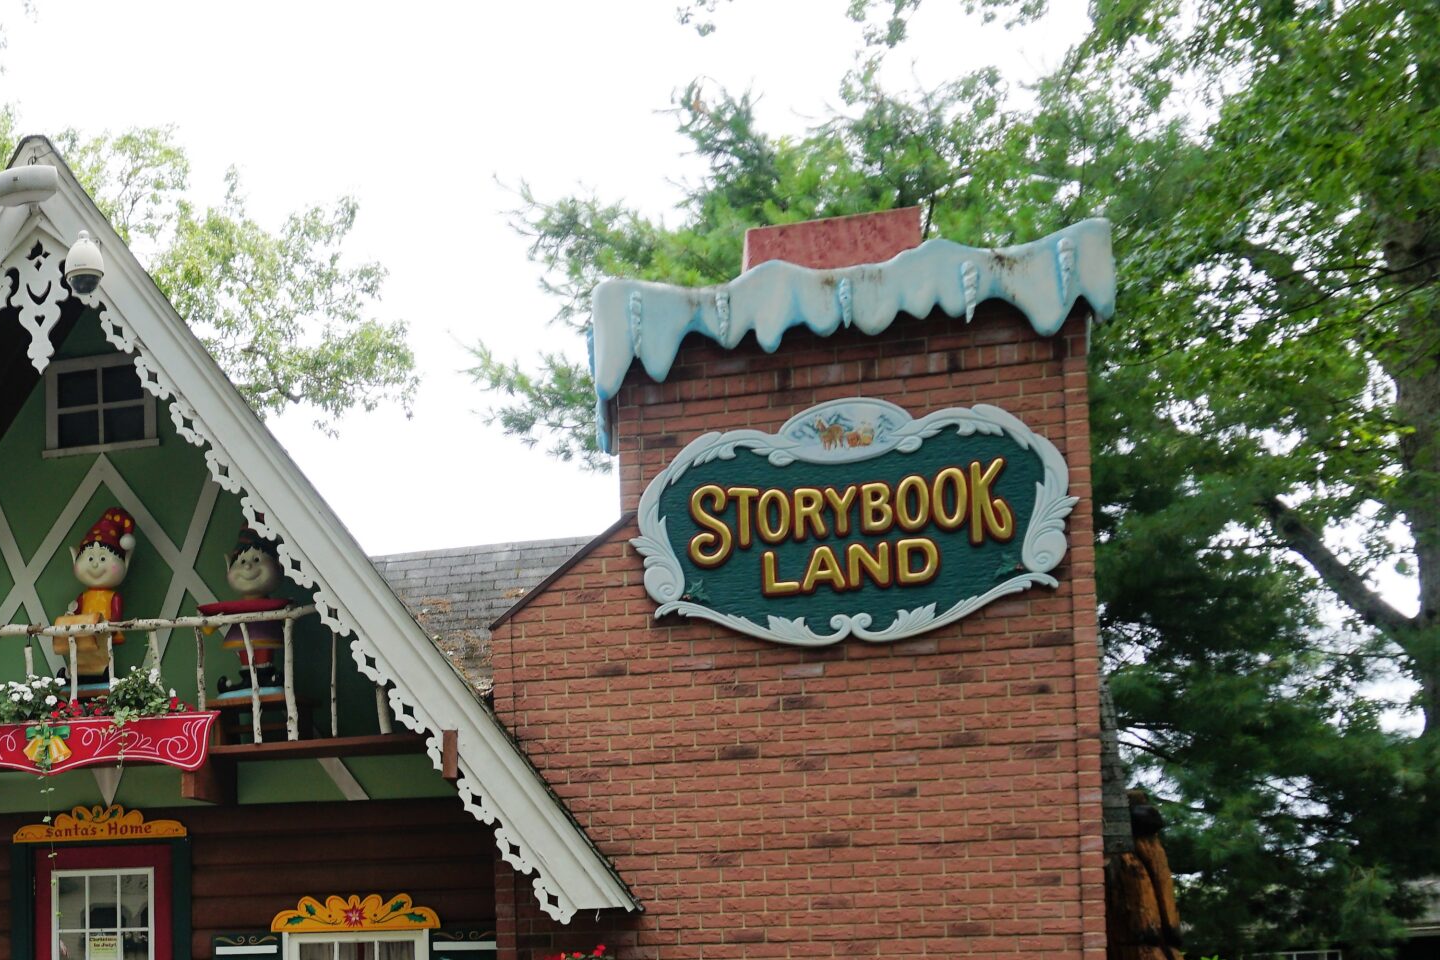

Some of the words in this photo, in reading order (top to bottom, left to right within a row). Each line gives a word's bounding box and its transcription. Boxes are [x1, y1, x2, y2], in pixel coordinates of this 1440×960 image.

[689, 457, 1015, 567] STORYBOOK
[762, 537, 940, 597] LAND
[107, 822, 152, 836] Home
